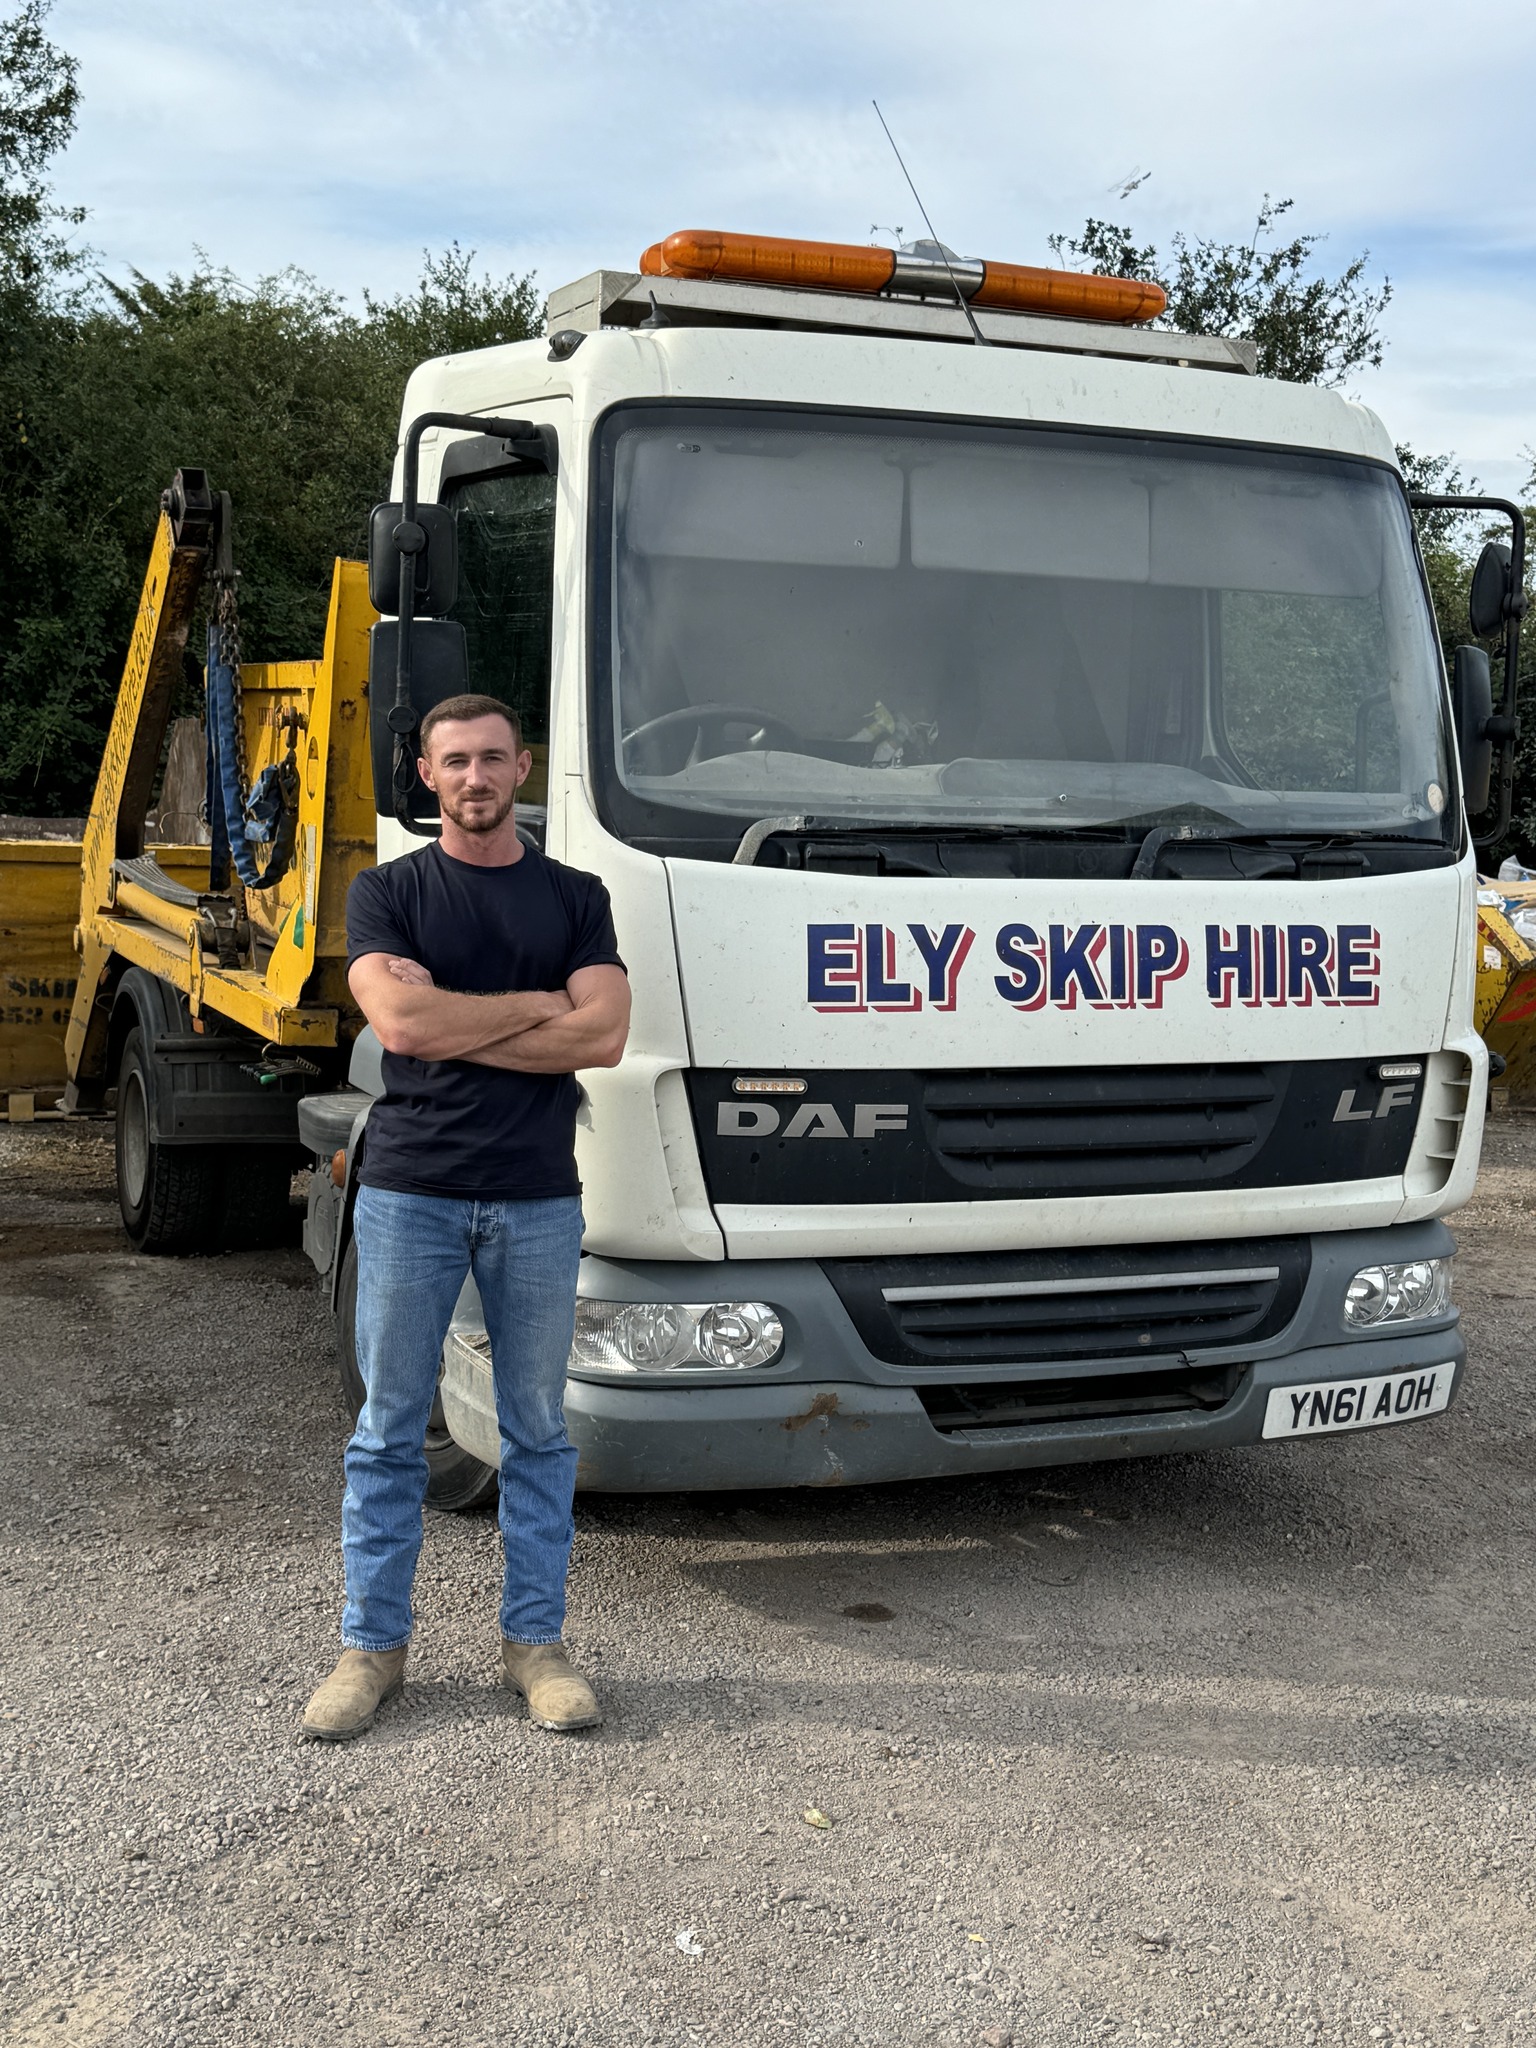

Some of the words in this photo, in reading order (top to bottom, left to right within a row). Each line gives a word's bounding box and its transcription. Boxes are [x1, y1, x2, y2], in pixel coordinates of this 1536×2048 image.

[806, 923, 977, 1012] ELY
[994, 923, 1190, 1012] SKIP
[1204, 924, 1381, 1009] HIRE
[716, 1101, 909, 1138] DAF
[1332, 1083, 1416, 1122] LF
[1290, 1385, 1368, 1429] YN61
[1372, 1373, 1437, 1419] AOH
